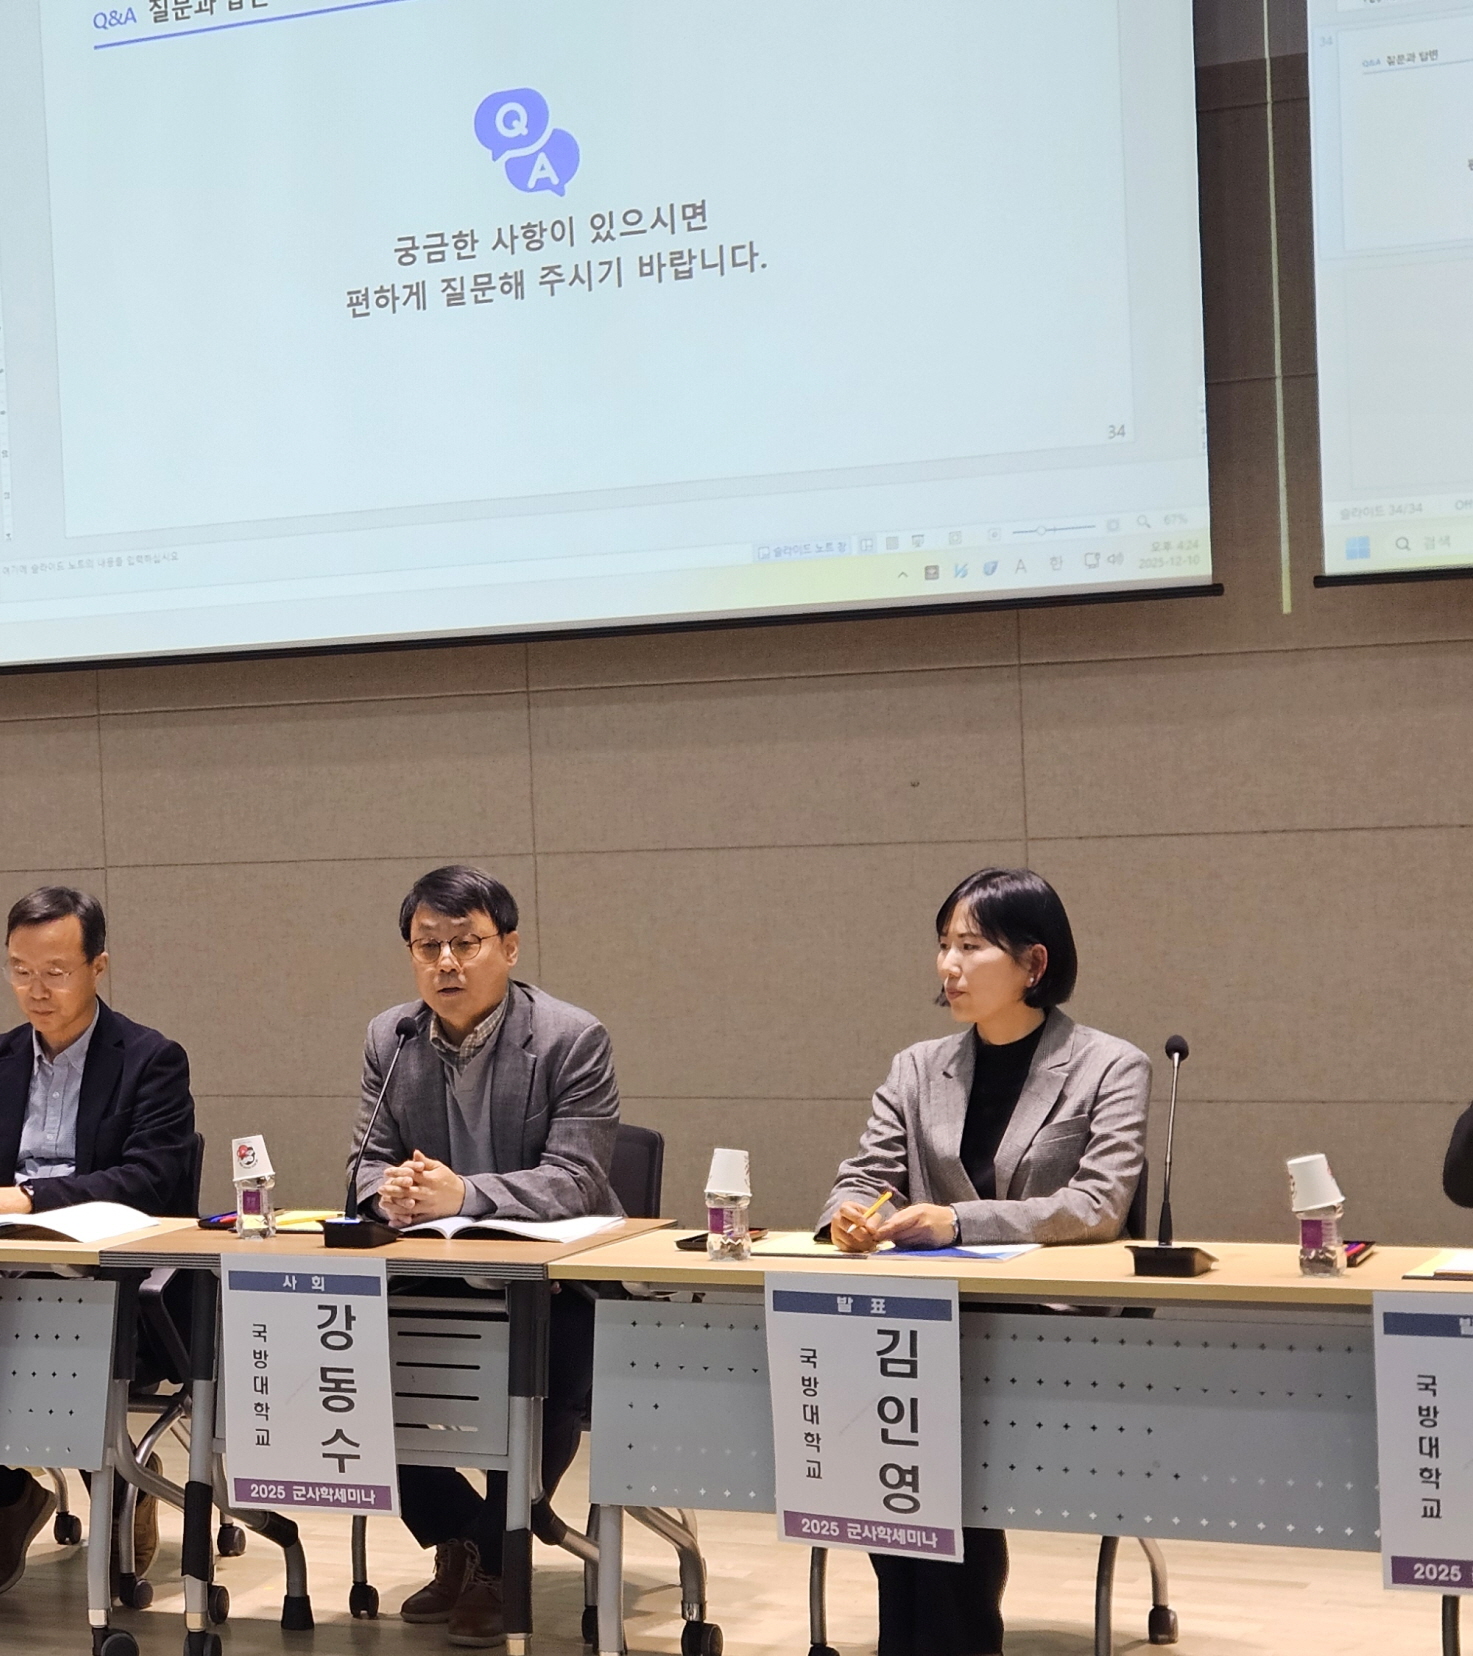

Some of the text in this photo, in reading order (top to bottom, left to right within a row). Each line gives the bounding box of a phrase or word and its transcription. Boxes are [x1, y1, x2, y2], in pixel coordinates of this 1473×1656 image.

[93, 8, 137, 30] Q&A
[1386, 52, 1416, 66] 질문과
[495, 102, 528, 138] Q
[527, 151, 559, 188] A
[393, 200, 709, 267] 궁금한 사항이 있으시면
[346, 240, 768, 318] 편하게 질문해 주시기 바랍니다.
[1108, 424, 1126, 440] 34
[283, 1275, 325, 1291] 사회
[837, 1296, 886, 1314] 발표
[252, 1323, 271, 1446] 국방대학교
[316, 1304, 360, 1474] 강동수
[799, 1348, 823, 1480] 국방대학교
[876, 1328, 921, 1515] 김인영
[1417, 1374, 1442, 1519] 국방대학교
[250, 1484, 376, 1505] 2025 군사학세미나
[801, 1518, 938, 1548] 2025 군사학세미나
[1413, 1563, 1461, 1582] 2025
